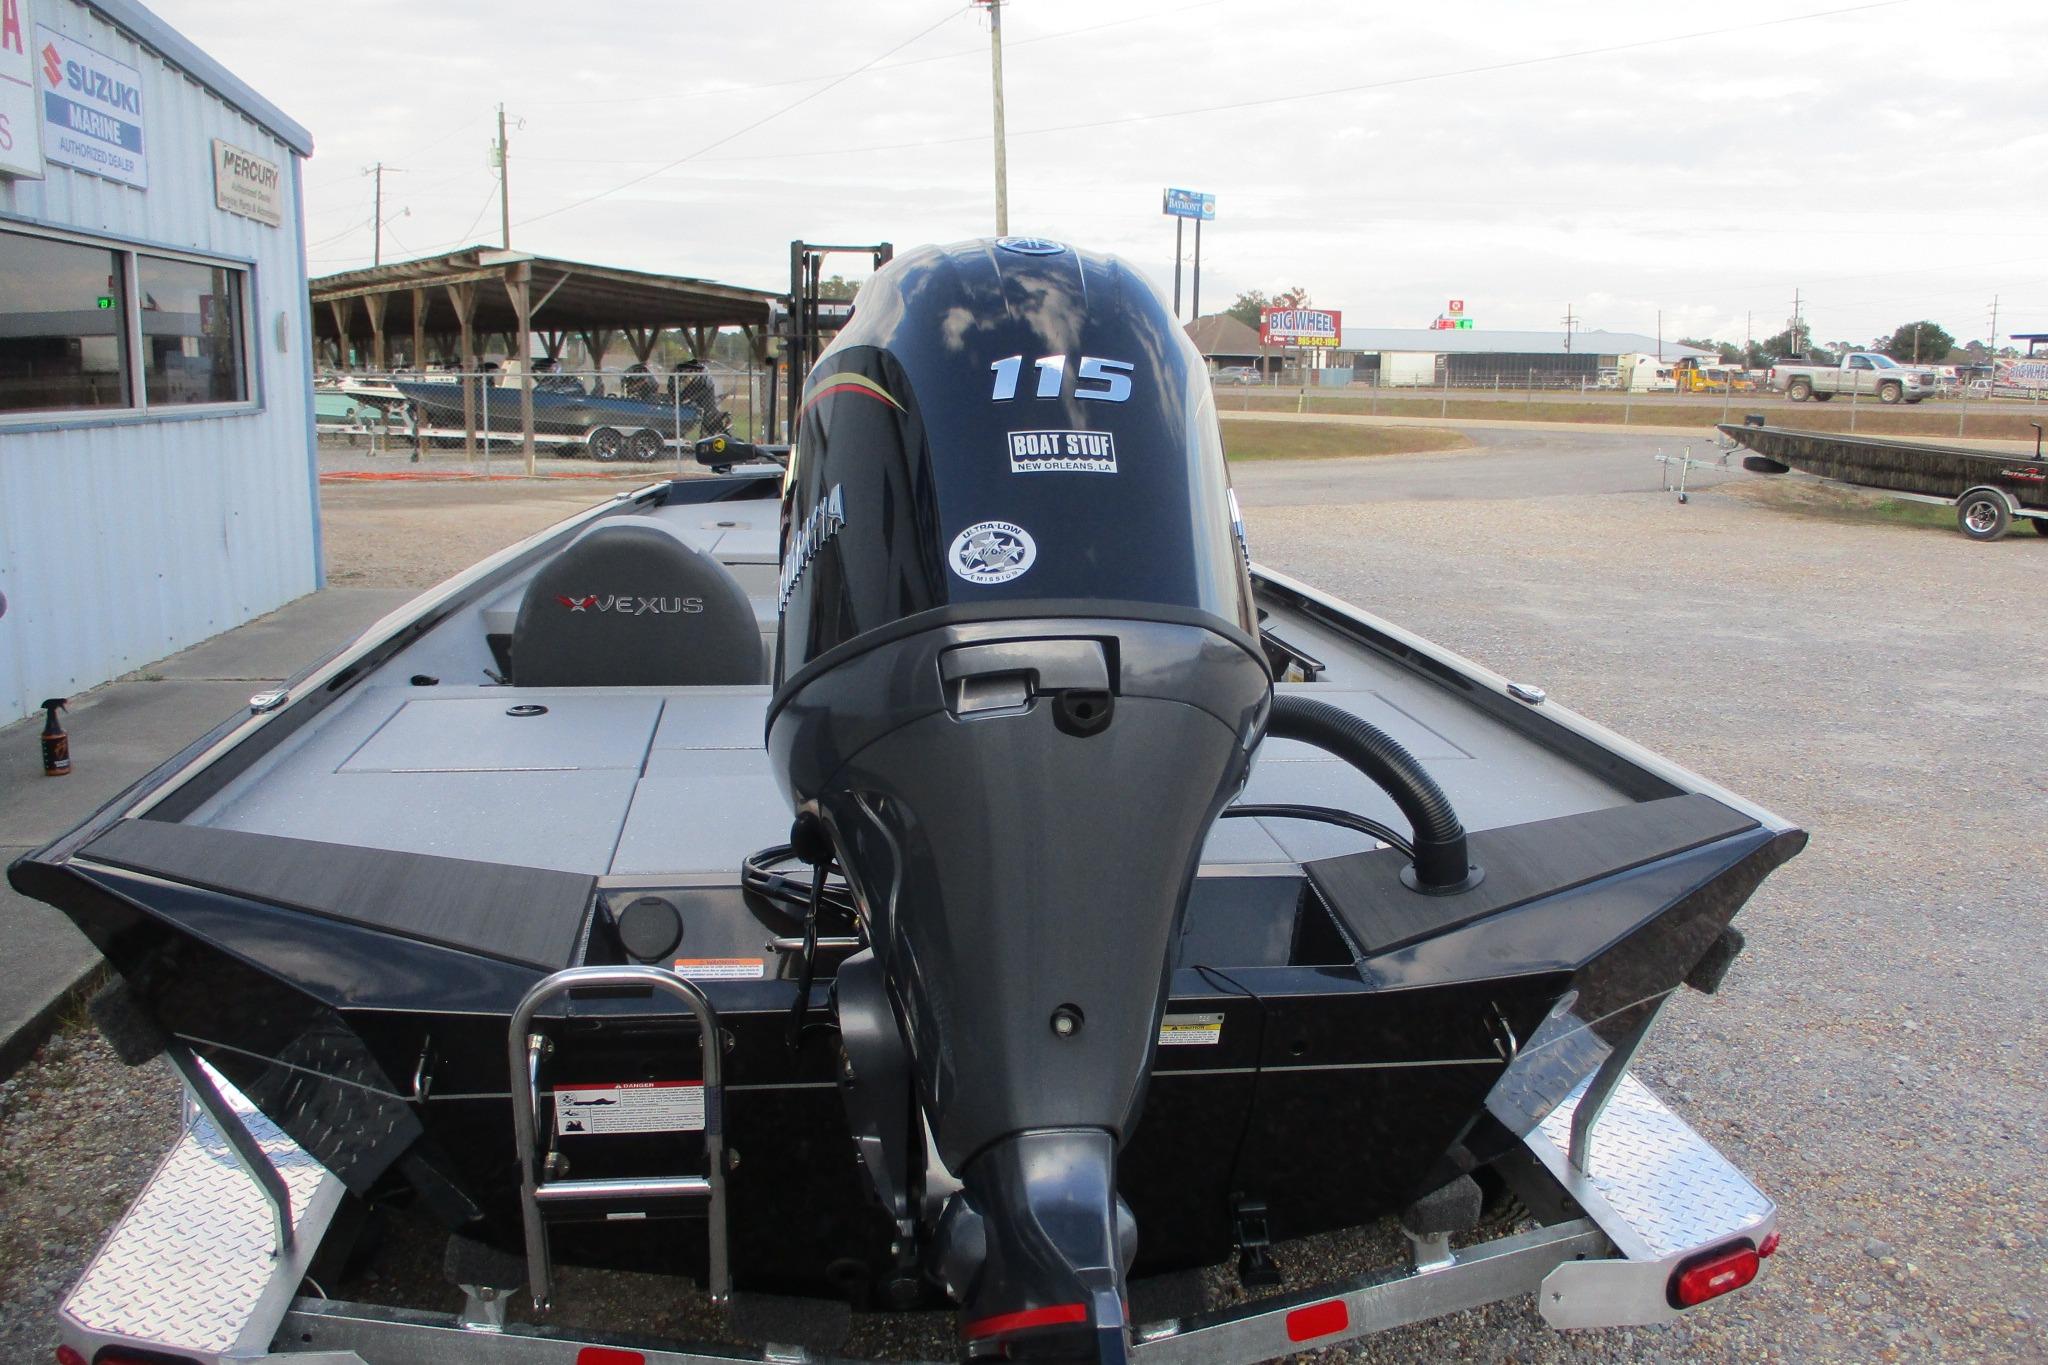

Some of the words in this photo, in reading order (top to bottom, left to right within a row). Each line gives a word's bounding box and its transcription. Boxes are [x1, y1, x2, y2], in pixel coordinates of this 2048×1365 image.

[66, 59, 141, 116] SUZUKI
[69, 103, 122, 145] MARINE
[60, 136, 108, 165] AUTHORIZED
[108, 153, 135, 172] DEALER
[223, 149, 279, 190] MERCURY
[1169, 197, 1201, 212] BAYMONT
[1270, 311, 1292, 330] BIG
[1294, 310, 1335, 332] WHEEL
[990, 354, 1135, 403] 115
[1013, 434, 1060, 456] BOAT
[1066, 434, 1110, 456] STUF
[1018, 462, 1042, 471] NEW
[970, 571, 1018, 582] EMISSION
[595, 594, 704, 616] VEXUS
